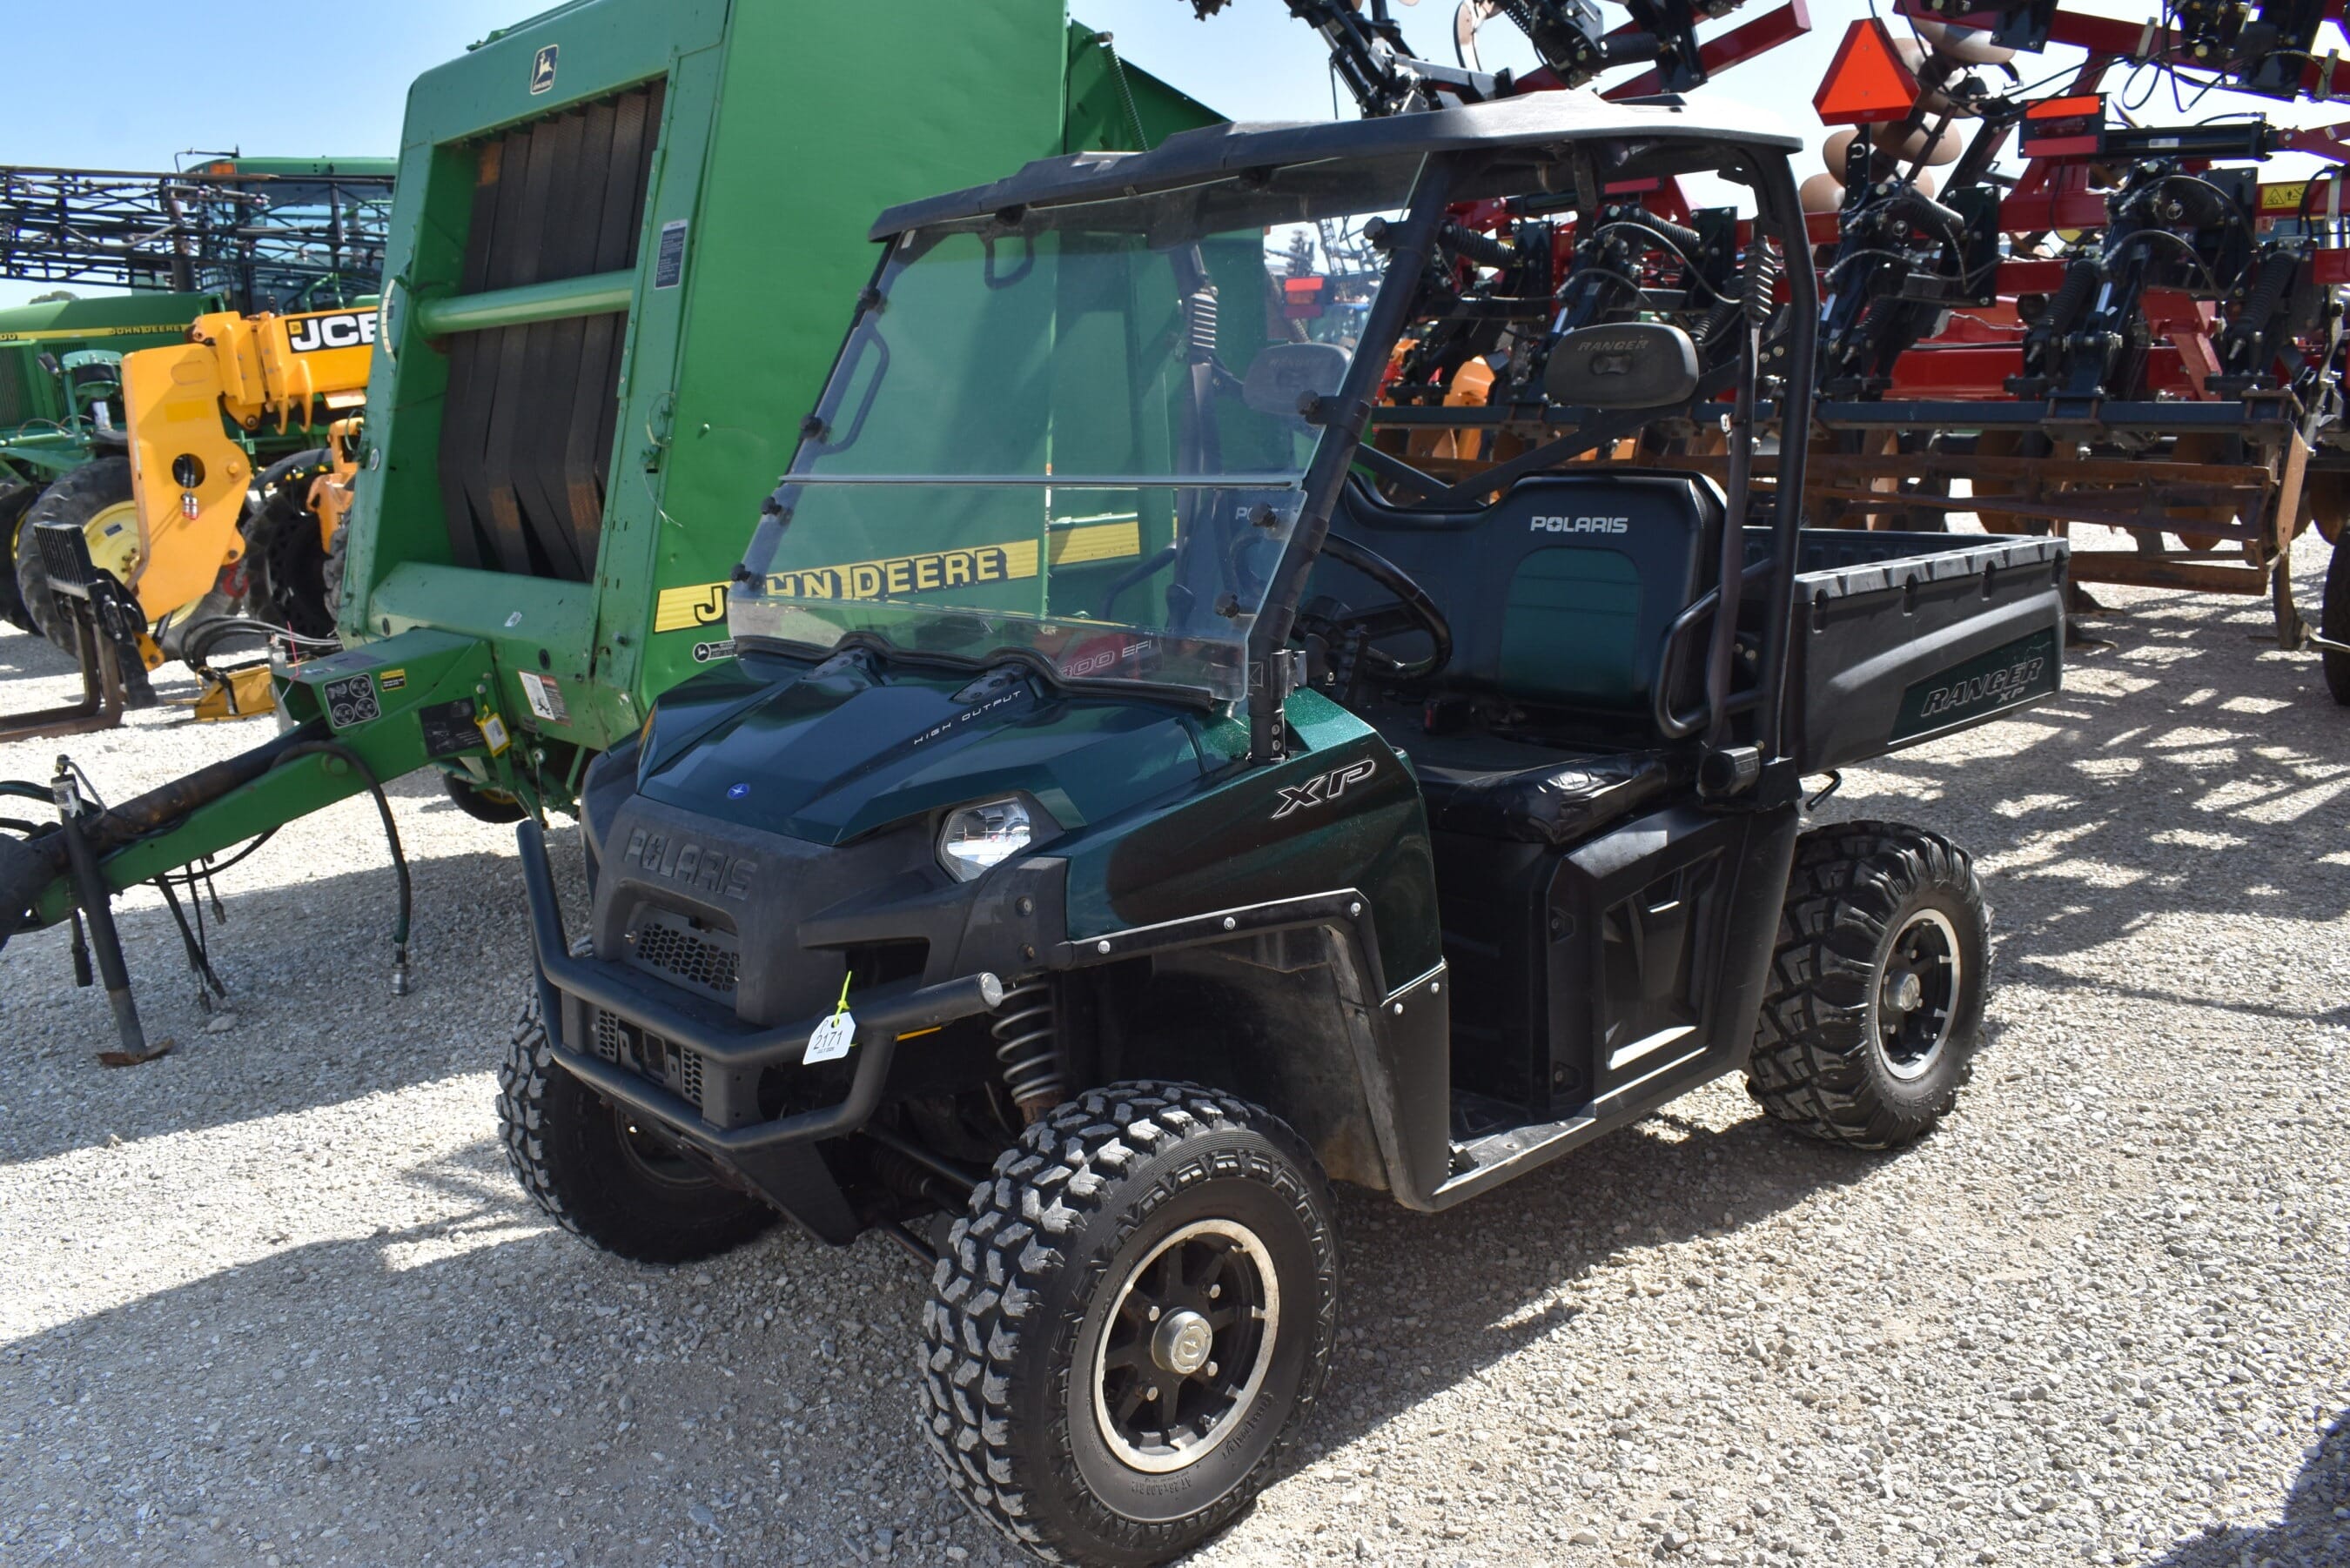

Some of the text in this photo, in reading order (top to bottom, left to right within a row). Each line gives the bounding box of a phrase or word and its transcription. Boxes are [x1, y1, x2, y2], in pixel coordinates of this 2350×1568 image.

[141, 324, 182, 334] DEERE
[1577, 339, 1649, 352] RANGER
[1530, 516, 1628, 533] POLARIS
[694, 547, 1007, 626] JHN DEERE
[1122, 640, 1152, 658] EFI
[1920, 656, 2044, 718] RANGER
[1997, 686, 2025, 704] XP
[913, 689, 1022, 746] HIGH OUTPUT
[1270, 758, 1376, 820] XP
[623, 827, 759, 901] POLARIS
[813, 1029, 843, 1050] 2171
